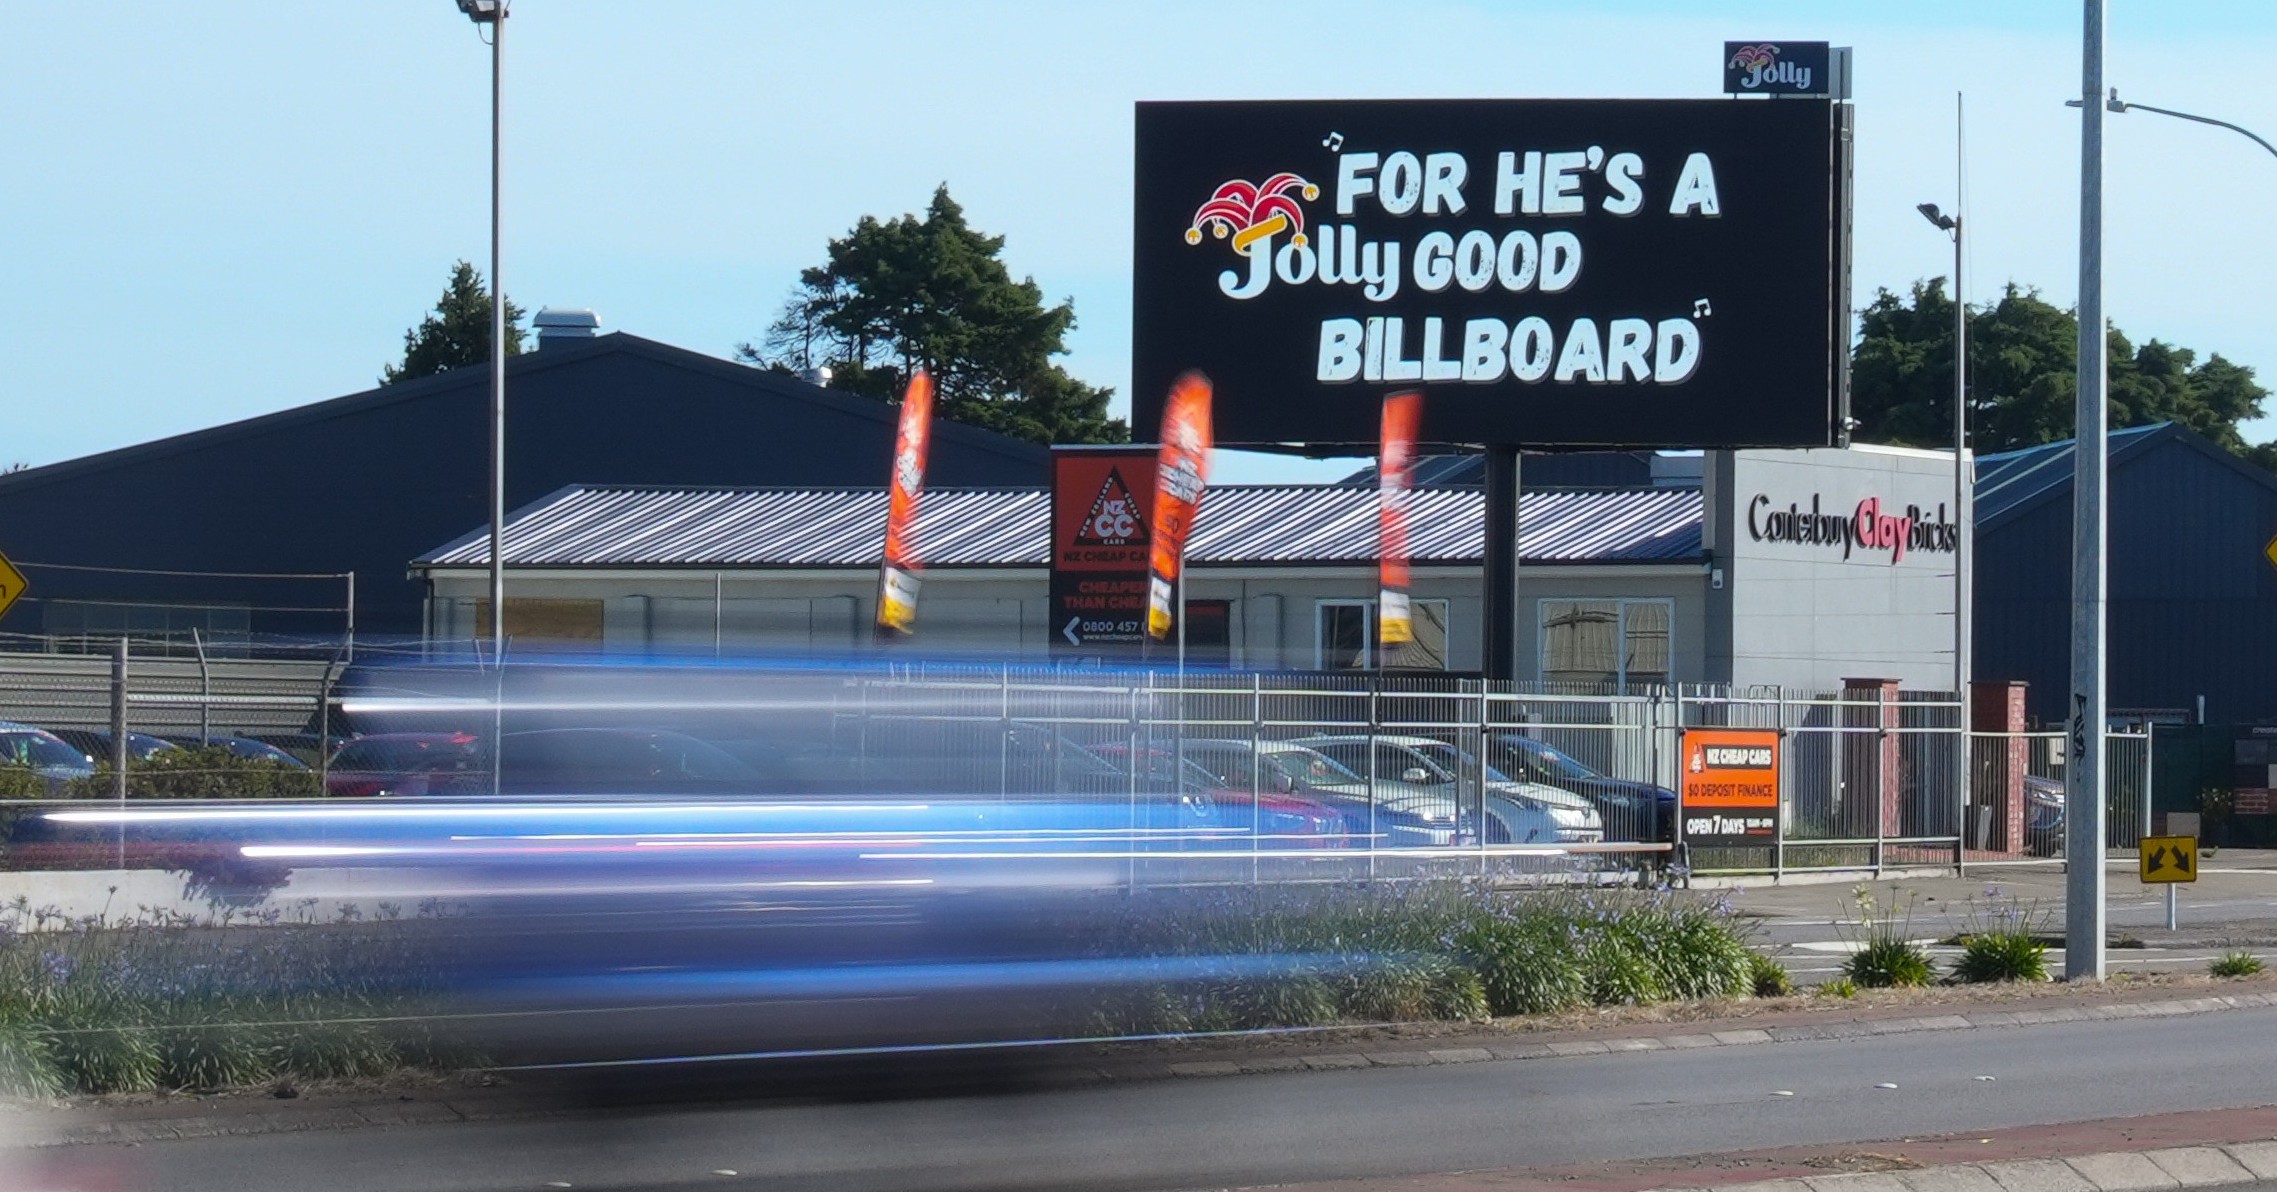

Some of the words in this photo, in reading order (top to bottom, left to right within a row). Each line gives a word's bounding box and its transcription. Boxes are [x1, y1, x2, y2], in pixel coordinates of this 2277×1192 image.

[1741, 62, 1811, 89] Jolly
[1336, 151, 1470, 217] FOR
[1494, 146, 1646, 218] HE'S
[1668, 151, 1722, 218] A
[1218, 224, 1399, 301] Jolly
[1412, 229, 1583, 293] GOOD
[1317, 316, 1702, 385] BILLBOARD
[1103, 500, 1126, 515] NZ
[1095, 514, 1134, 537] CC
[1064, 551, 1081, 561] NZ
[1084, 551, 1126, 562] CHEAP
[1129, 551, 1149, 562] CA
[1063, 595, 1104, 609] THAN
[1082, 621, 1115, 632] 0800
[1117, 621, 1139, 632] 457
[1706, 748, 1720, 765] NZ
[1720, 748, 1748, 765] CHEAP
[1749, 748, 1772, 766] CARS
[1689, 783, 1700, 797] $0
[1701, 784, 1735, 797] DEPOSIT
[1737, 784, 1773, 797] FINANCE
[1687, 818, 1712, 834] OPEN
[1713, 815, 1721, 834] 7
[1721, 818, 1746, 834] DAYS
